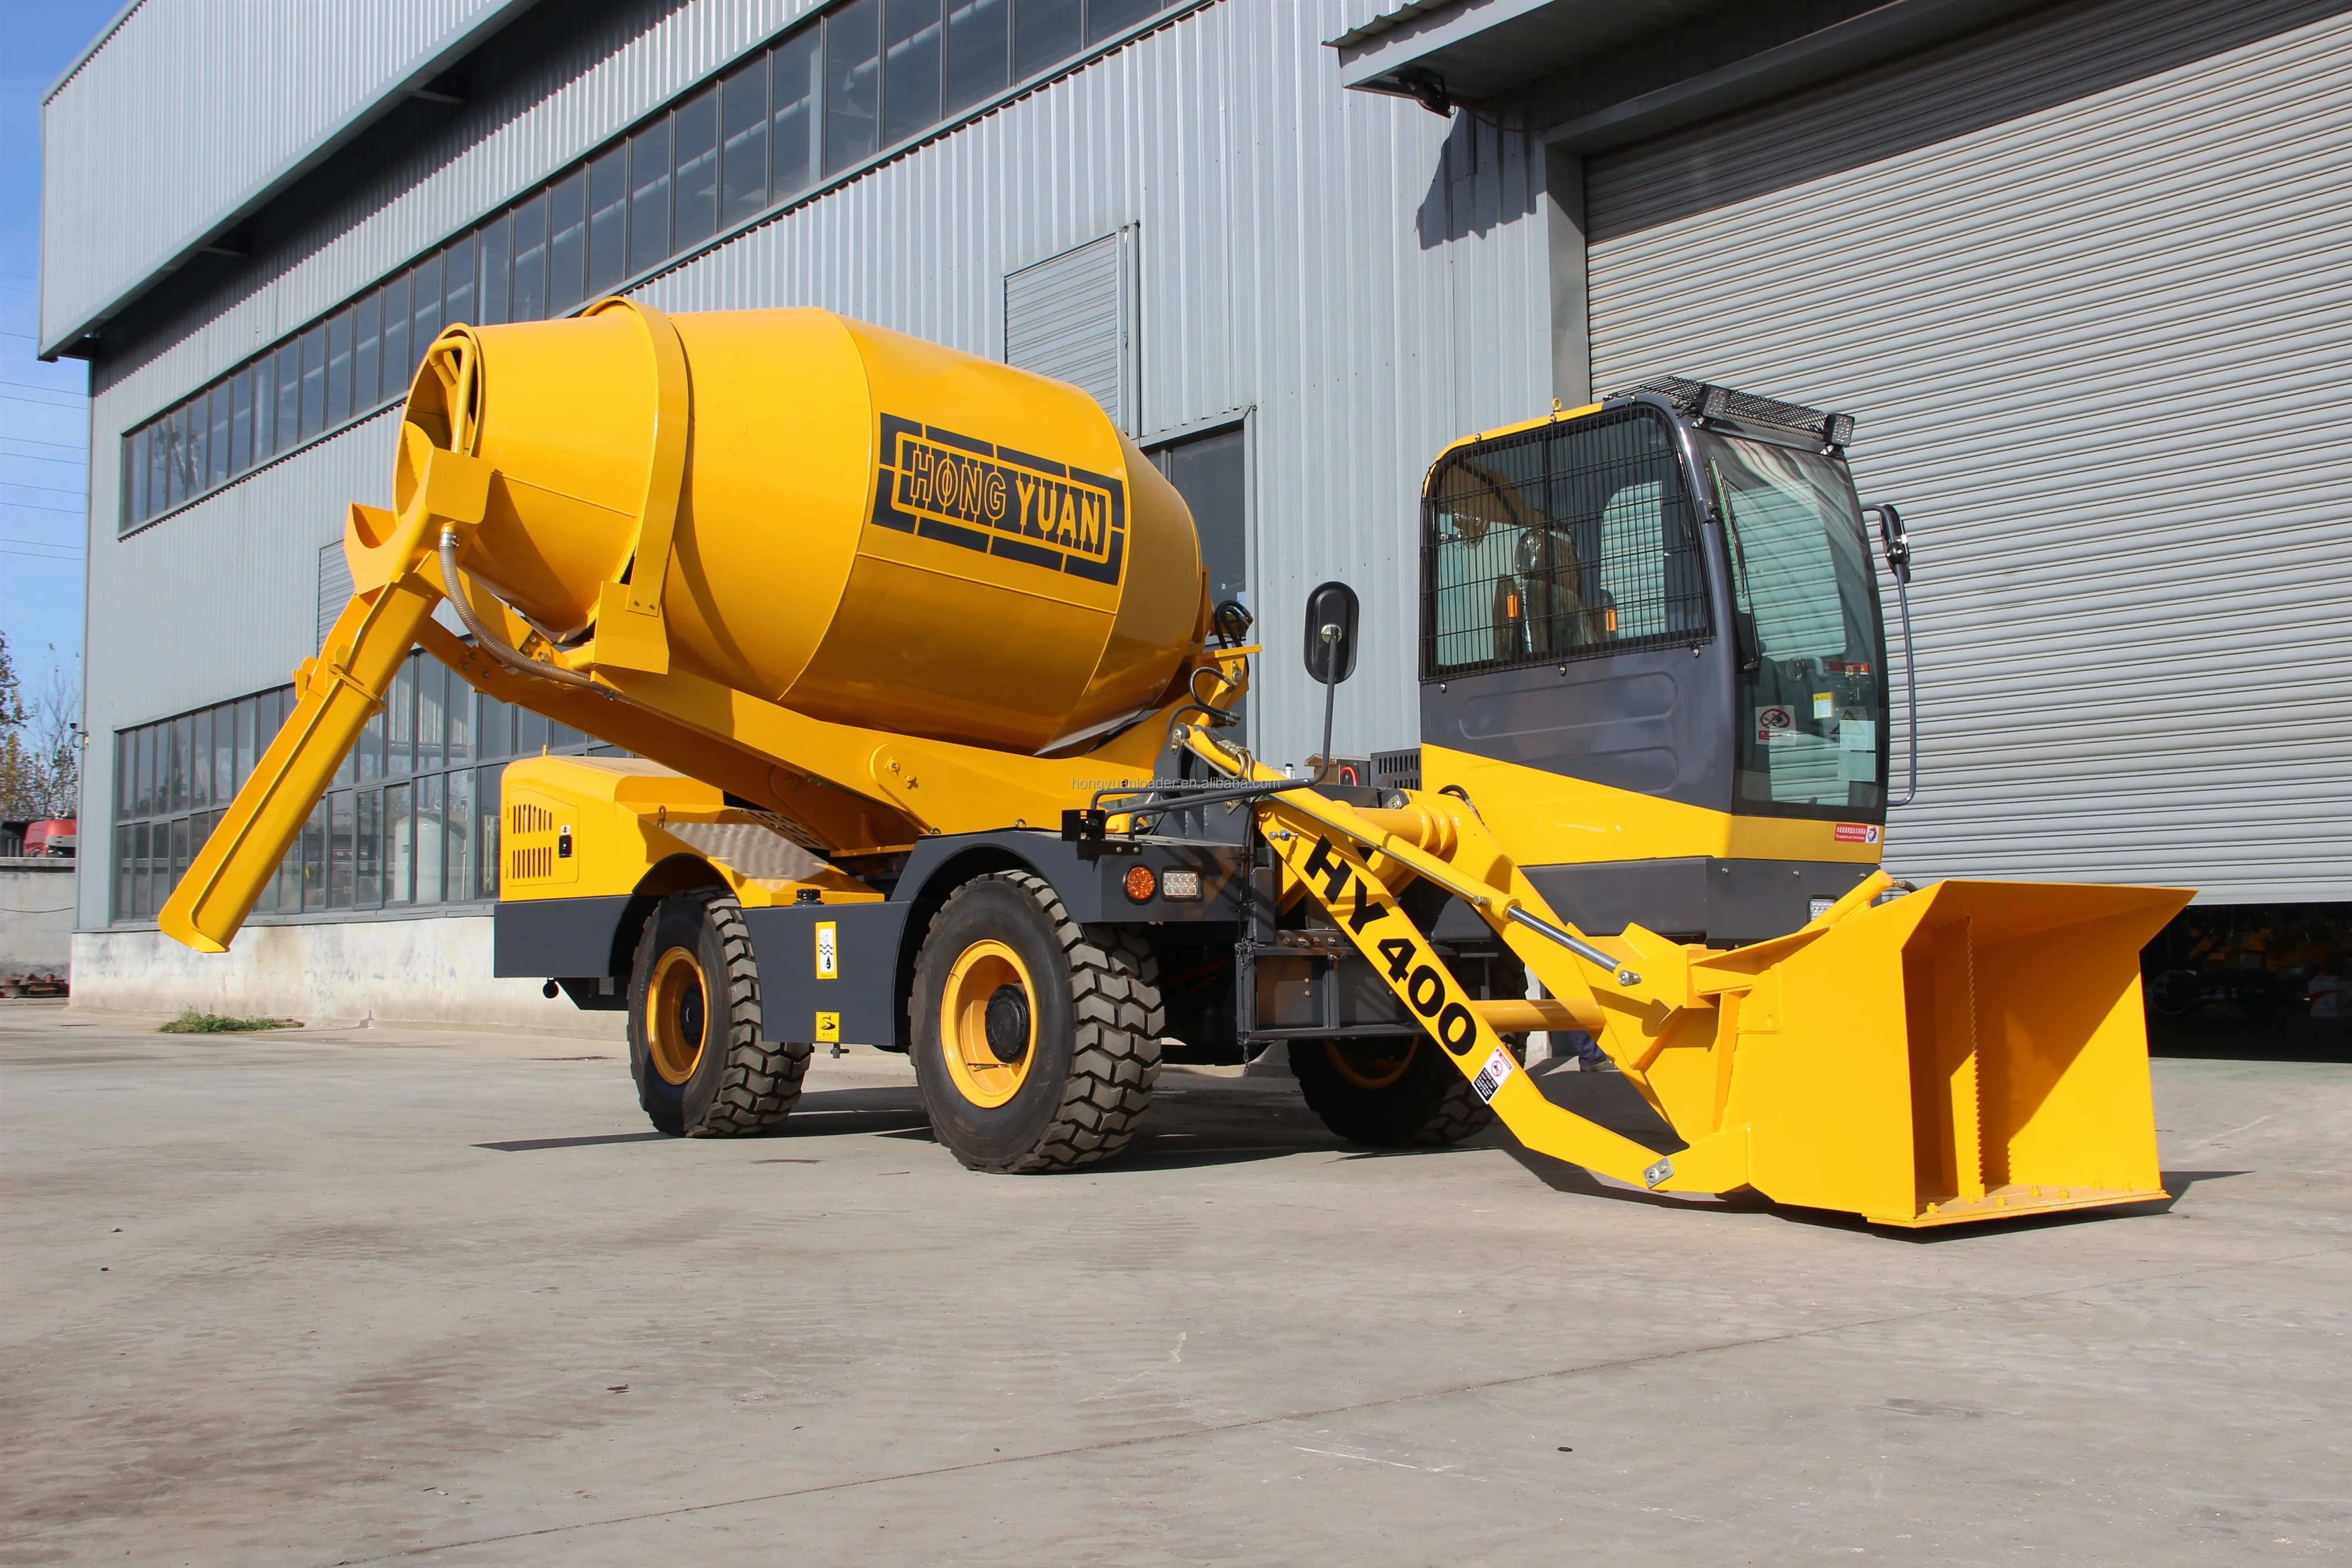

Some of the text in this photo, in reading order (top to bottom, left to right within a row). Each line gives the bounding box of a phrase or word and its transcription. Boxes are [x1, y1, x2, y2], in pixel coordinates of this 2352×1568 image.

[910, 450, 1100, 545] HONG YUAN
[1304, 834, 1476, 1057] HY 400
